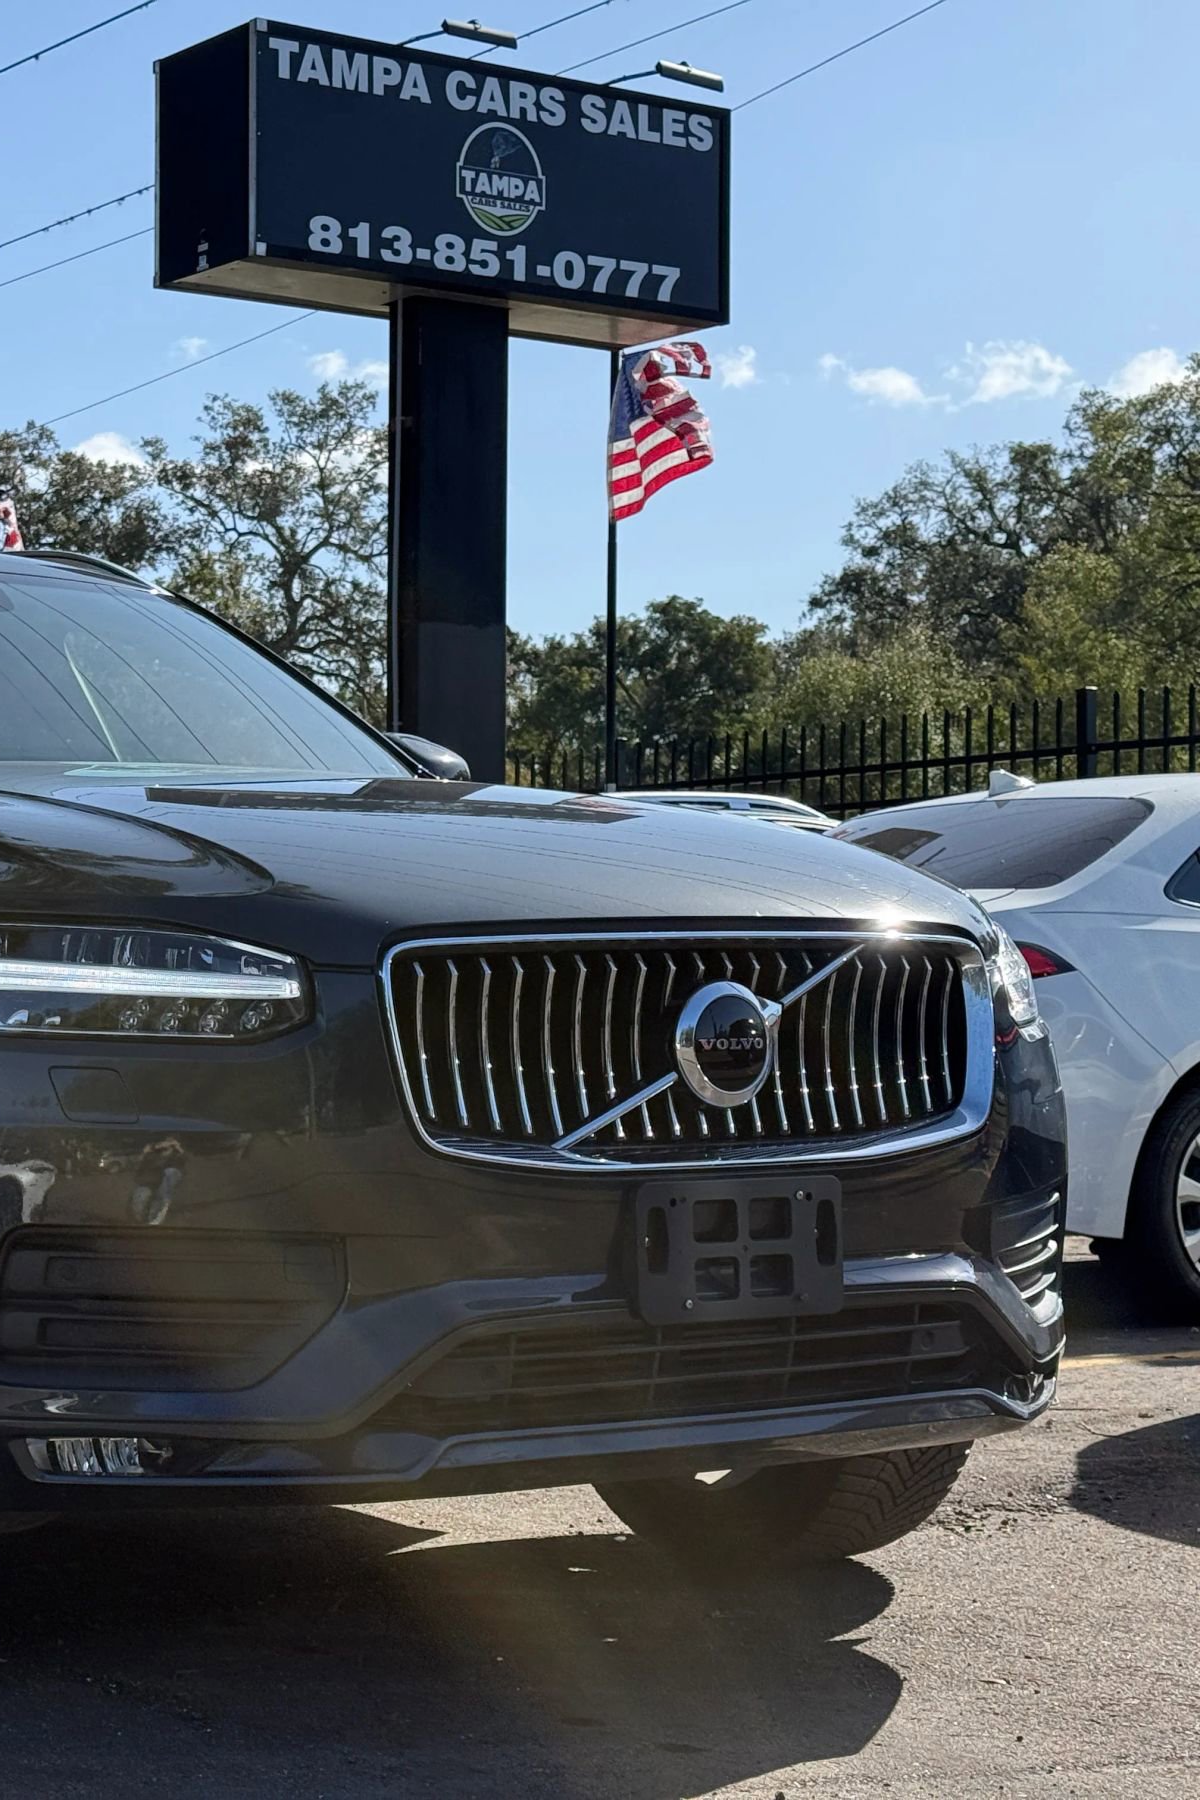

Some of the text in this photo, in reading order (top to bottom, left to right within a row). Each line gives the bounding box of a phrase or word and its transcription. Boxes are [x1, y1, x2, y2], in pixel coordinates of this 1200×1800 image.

[269, 37, 714, 152] TAMPA CARS SALES
[461, 169, 541, 203] TAMPA
[471, 197, 531, 213] CARS SALES
[308, 215, 681, 303] 813-851-0777
[698, 1037, 764, 1051] VOLVO
